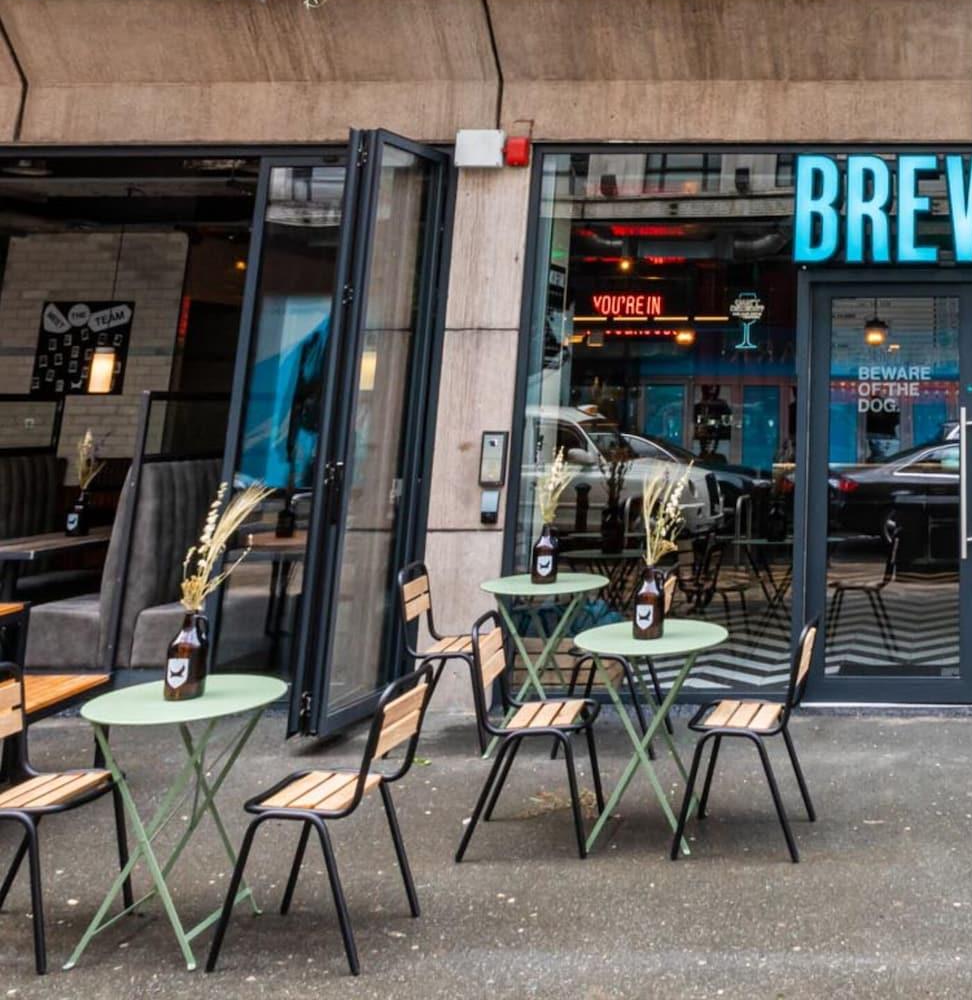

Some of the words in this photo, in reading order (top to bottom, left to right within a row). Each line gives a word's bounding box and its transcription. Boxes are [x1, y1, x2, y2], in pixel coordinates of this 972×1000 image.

[593, 295, 644, 315] YOU'RE
[646, 295, 661, 315] IN
[71, 312, 87, 320] THE
[95, 310, 126, 327] TEAM
[858, 366, 932, 380] BEWARE
[858, 382, 881, 396] OF
[887, 382, 920, 396] THE
[858, 398, 901, 413] DOG.
